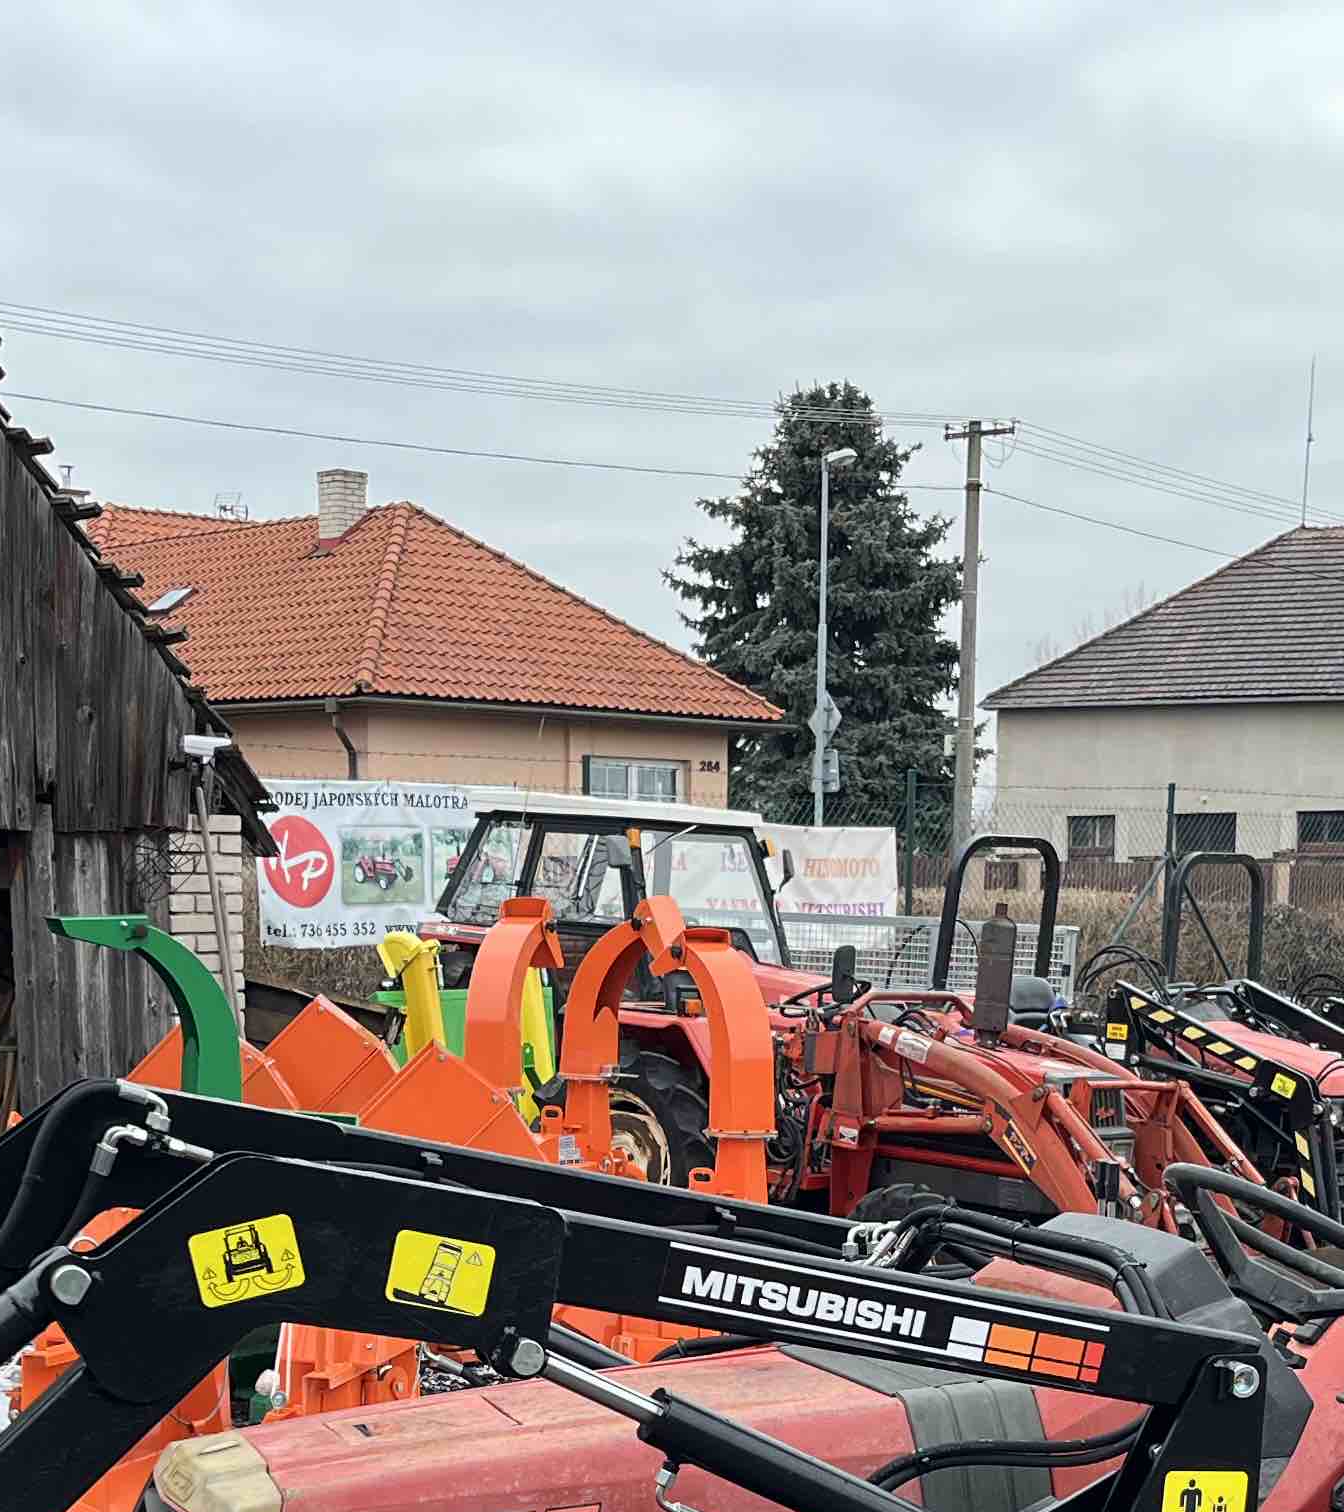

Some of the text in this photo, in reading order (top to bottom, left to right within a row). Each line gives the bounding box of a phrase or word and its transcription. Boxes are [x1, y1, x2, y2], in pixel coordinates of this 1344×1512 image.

[264, 791, 309, 810] RODEJ
[403, 792, 469, 809] MALOTRA
[325, 922, 348, 937] 455
[353, 921, 377, 936] 352
[384, 923, 417, 935] www
[682, 1266, 927, 1338] MITSUBISHI
